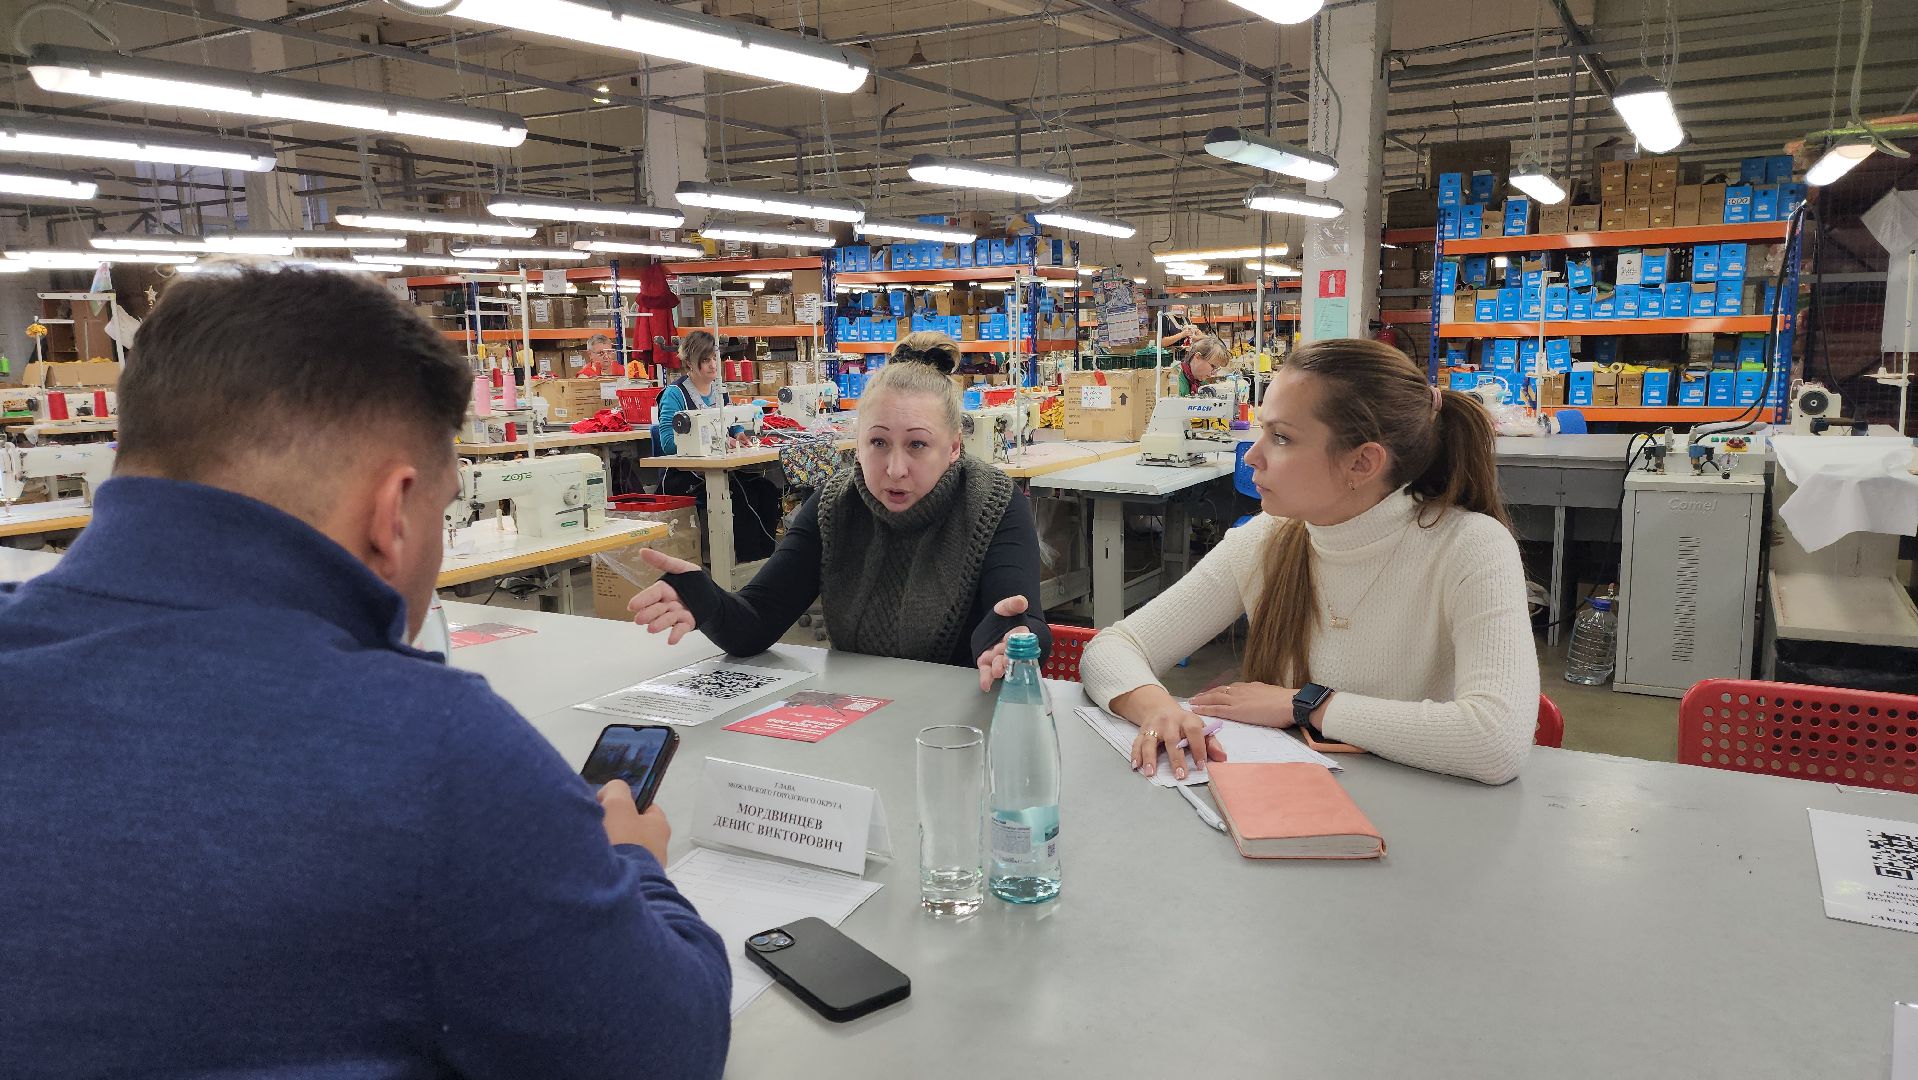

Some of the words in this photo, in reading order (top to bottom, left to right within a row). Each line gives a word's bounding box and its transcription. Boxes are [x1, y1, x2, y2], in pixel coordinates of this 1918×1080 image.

[1668, 496, 1718, 512] Camel
[728, 782, 773, 796] МОЖАЙСКОГО
[773, 790, 816, 804] ГОРОДСКОГО
[816, 798, 842, 809] ОКРУГА
[774, 782, 796, 791] ГЛАВА
[737, 803, 823, 830] МОРДВИНЦЕВ
[713, 815, 755, 834] ДЕНИС
[757, 824, 843, 853] ВИКТОРОВИЧ
